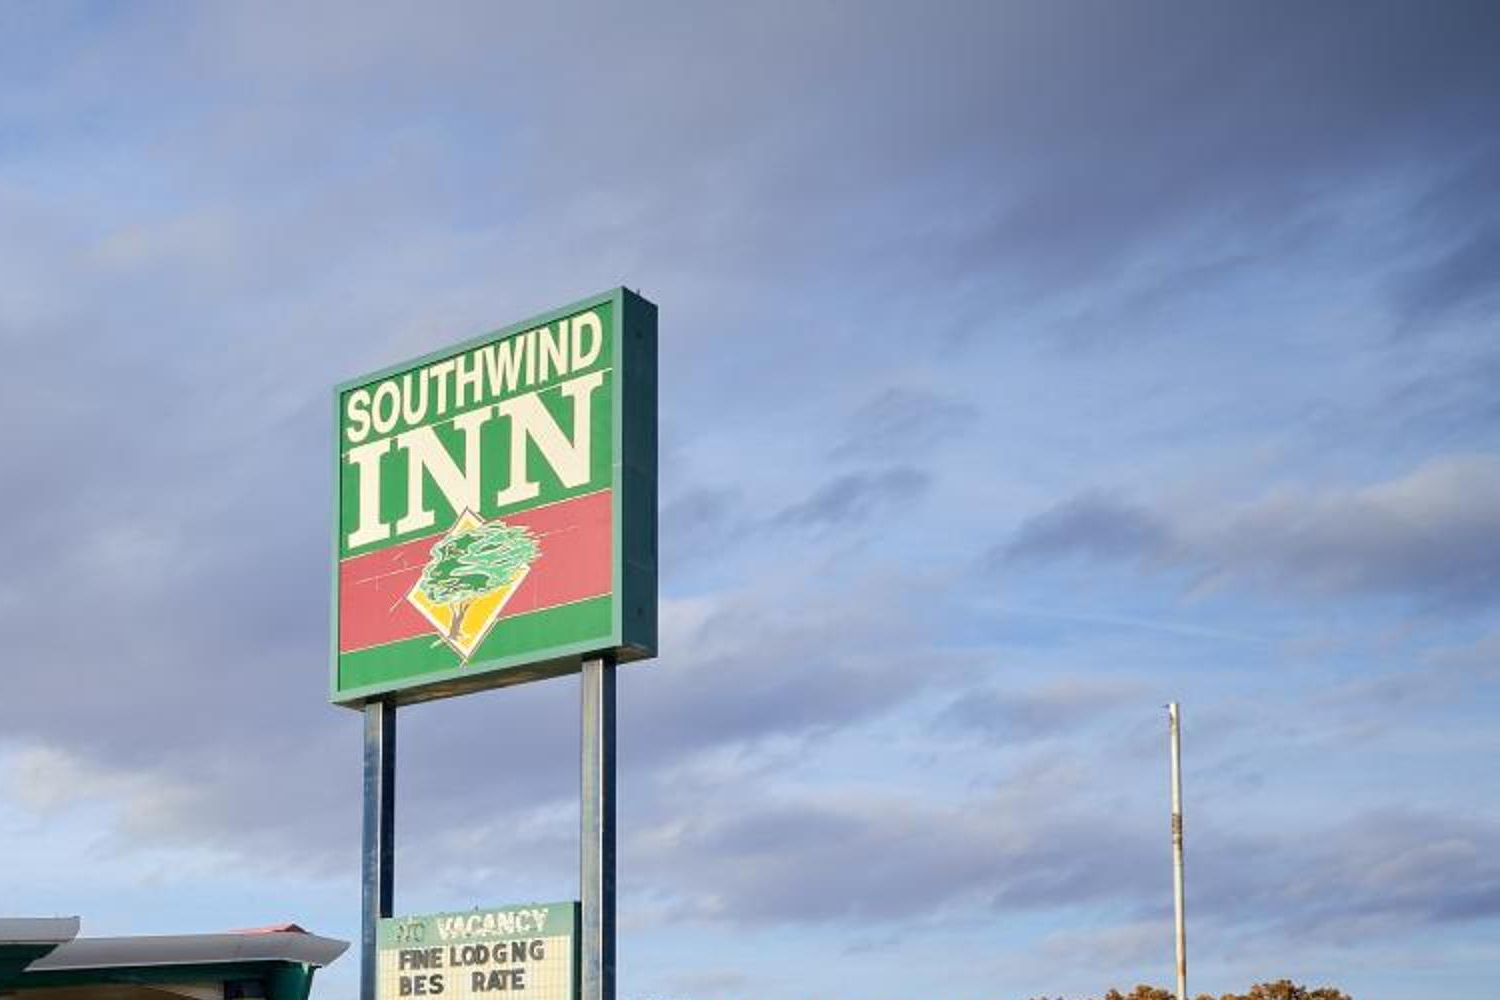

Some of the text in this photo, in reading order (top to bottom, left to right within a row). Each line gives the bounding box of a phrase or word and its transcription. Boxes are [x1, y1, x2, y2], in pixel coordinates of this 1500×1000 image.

[347, 310, 603, 443] SOUTHWIND
[347, 369, 604, 550] INN
[437, 908, 549, 940] VACANCY
[399, 947, 443, 971] FINE
[399, 968, 525, 996] BES RATE
